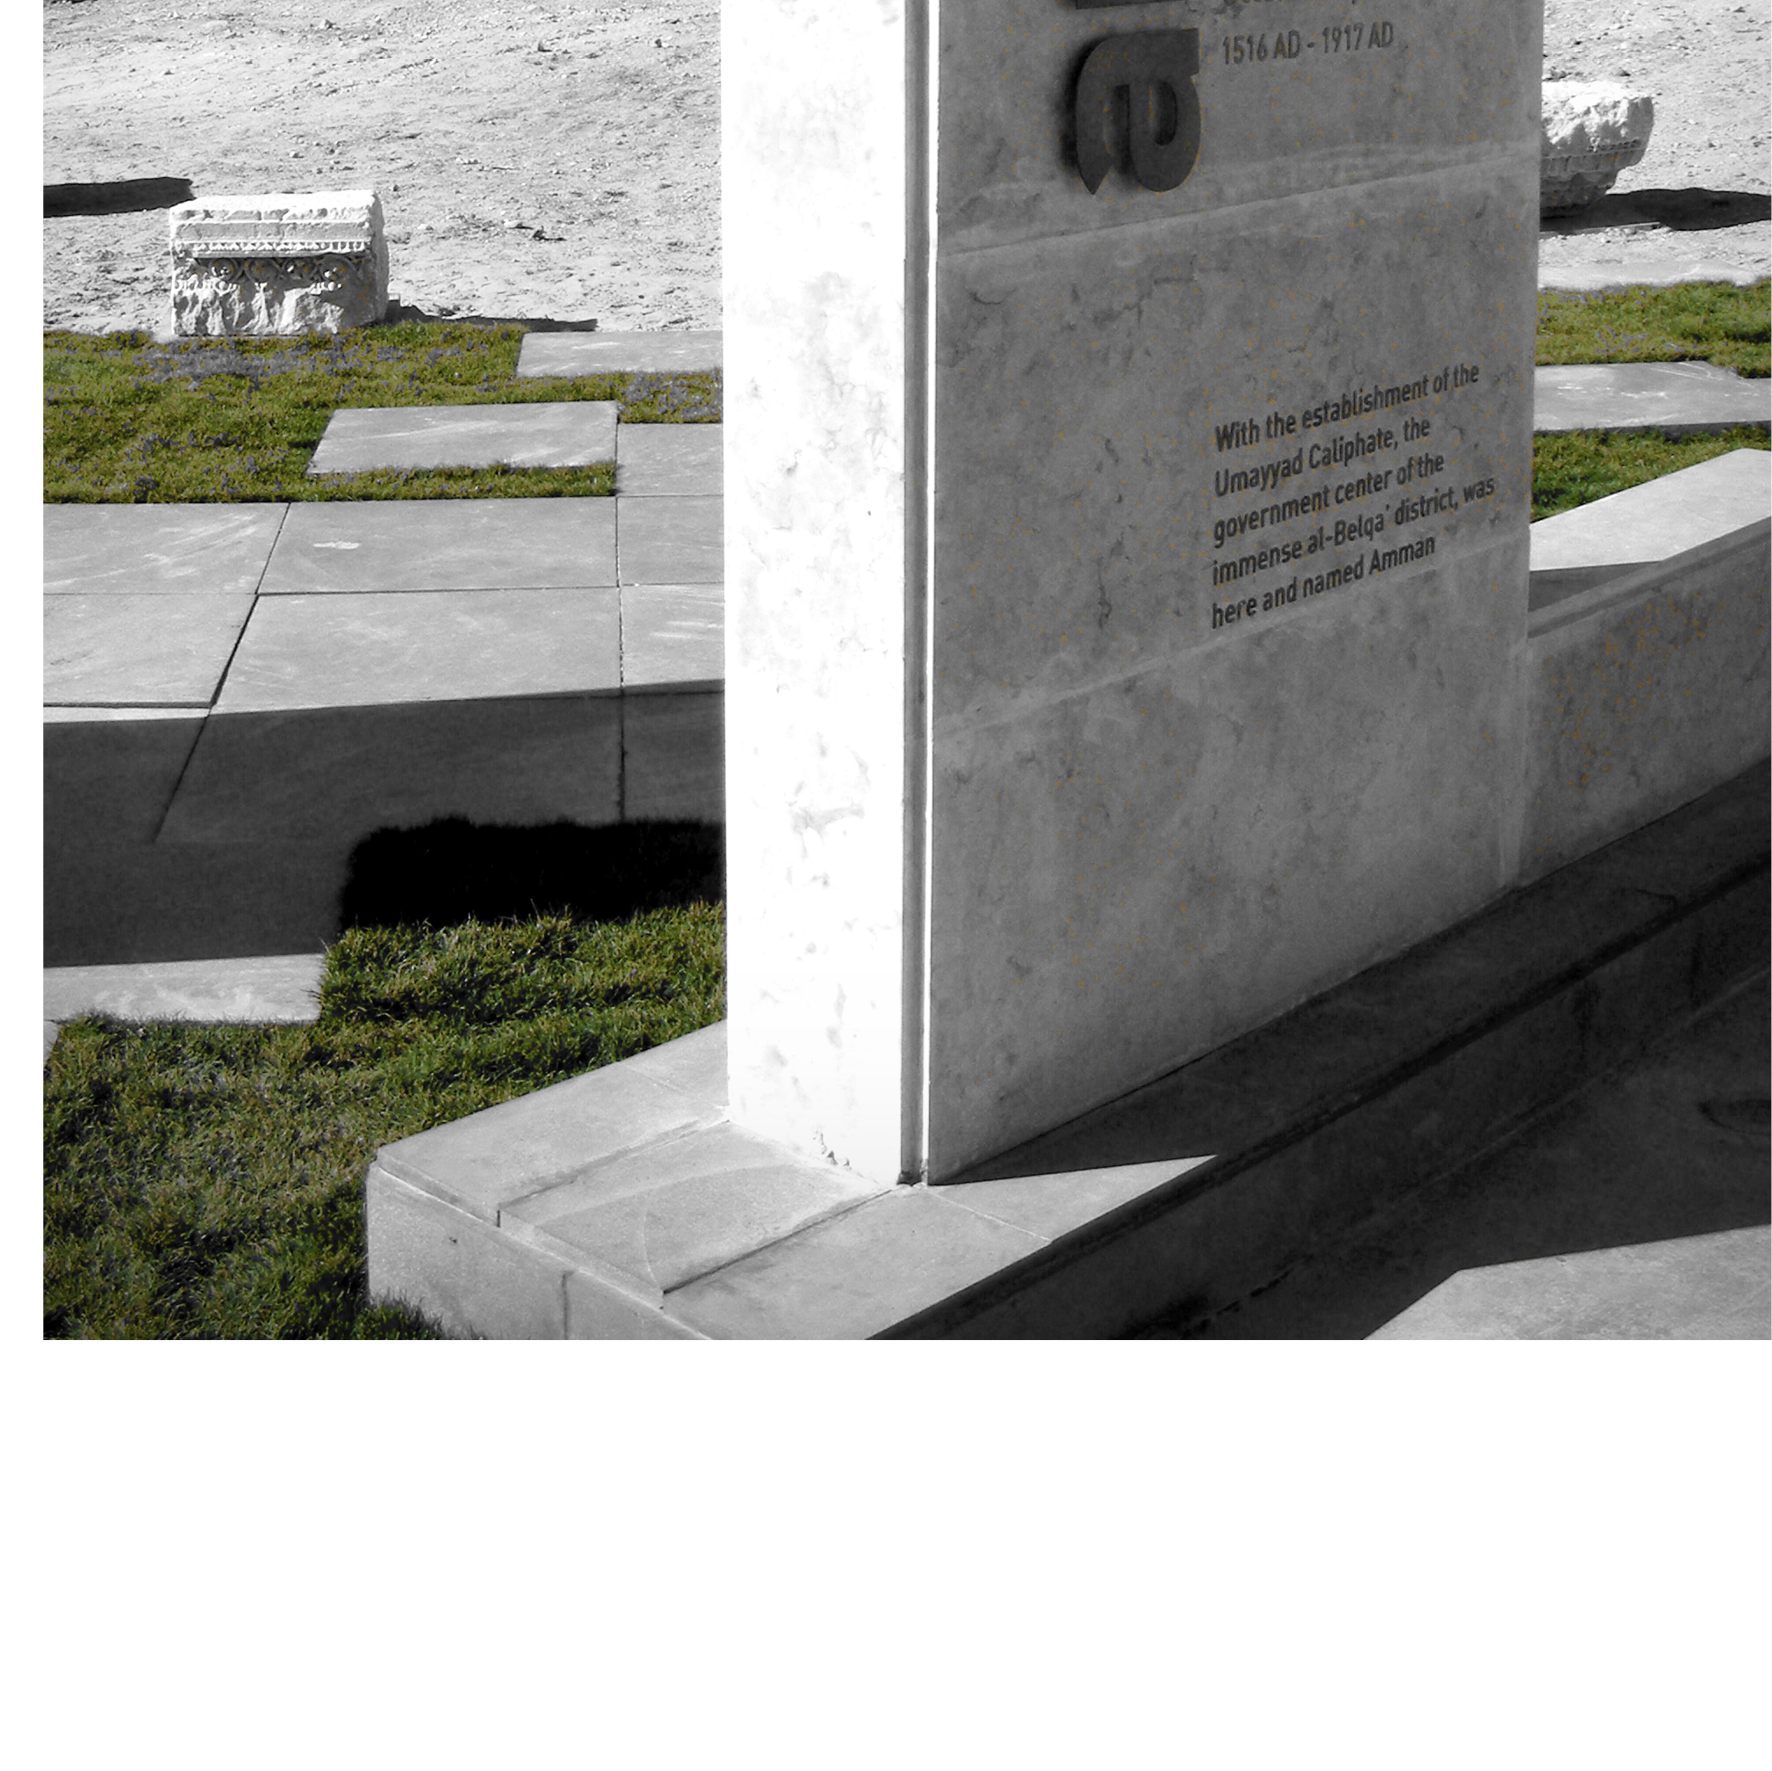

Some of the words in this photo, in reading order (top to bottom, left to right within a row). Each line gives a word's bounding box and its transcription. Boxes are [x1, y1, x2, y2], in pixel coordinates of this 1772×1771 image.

[1222, 33, 1268, 64] 1516
[1274, 29, 1300, 60] AD
[1322, 24, 1365, 54] 1917
[1367, 21, 1393, 49] AD
[1216, 417, 1260, 453] With
[1266, 412, 1296, 439] the
[1301, 374, 1429, 429] establishment
[1433, 369, 1450, 394] of
[1453, 362, 1480, 389] the
[1214, 485, 1329, 548] government
[1335, 469, 1392, 506] center
[1397, 459, 1415, 486] of
[1417, 452, 1445, 479] the
[1215, 448, 1303, 497] Umayyad
[1308, 427, 1399, 469] Caliphate,
[1403, 416, 1431, 443] the
[1212, 538, 1302, 586] immense
[1395, 487, 1459, 526] district,
[1463, 477, 1496, 504] was
[1212, 596, 1257, 629] here
[1263, 580, 1297, 611] and
[1303, 554, 1364, 598] named
[1369, 534, 1436, 575] Amman
